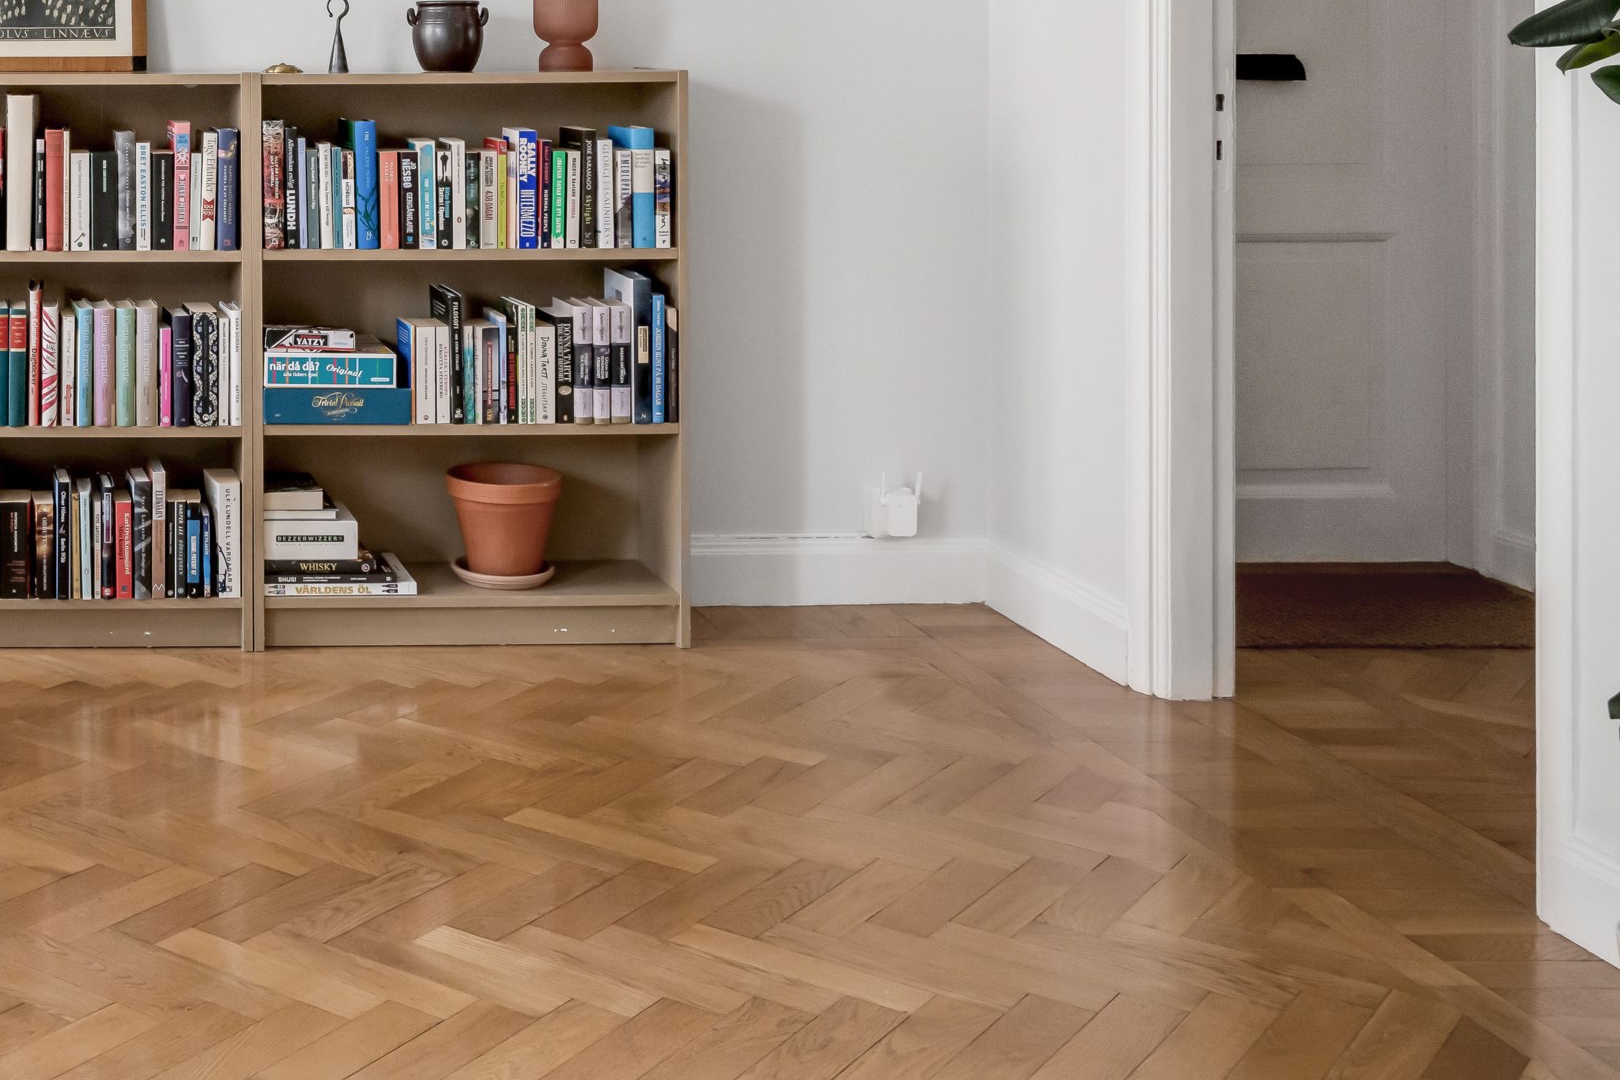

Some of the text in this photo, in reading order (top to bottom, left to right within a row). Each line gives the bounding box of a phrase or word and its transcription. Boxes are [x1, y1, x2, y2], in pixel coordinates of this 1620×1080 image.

[43, 28, 110, 39] LINNÆVS
[204, 138, 217, 193] Tage Erlander
[402, 158, 412, 189] NESBØ
[520, 138, 528, 183] ROONEY
[528, 142, 536, 177] SALLY
[286, 190, 296, 230] LUNDH
[406, 192, 415, 233] GENGÅNGARE
[485, 190, 494, 221] 438 DAGAR
[520, 190, 535, 237] INTERMEZZO
[584, 194, 592, 225] Skylight
[83, 315, 92, 383] Elena Ferrante
[101, 314, 110, 383] Elena Ferrante
[123, 315, 132, 384] Elena Ferrante
[143, 314, 152, 382] Elena Ferrante
[295, 338, 326, 346] YATZY
[540, 336, 550, 358] DONNA
[563, 323, 572, 382] DONNA TARTT
[655, 328, 663, 351] JORDEN
[269, 361, 319, 371] när då då?
[326, 363, 363, 378] Original
[541, 359, 550, 380] TARTT
[655, 368, 663, 376] PÅ
[300, 563, 337, 571] WHISKY
[295, 584, 372, 594] VÄRLDENS ÖL
